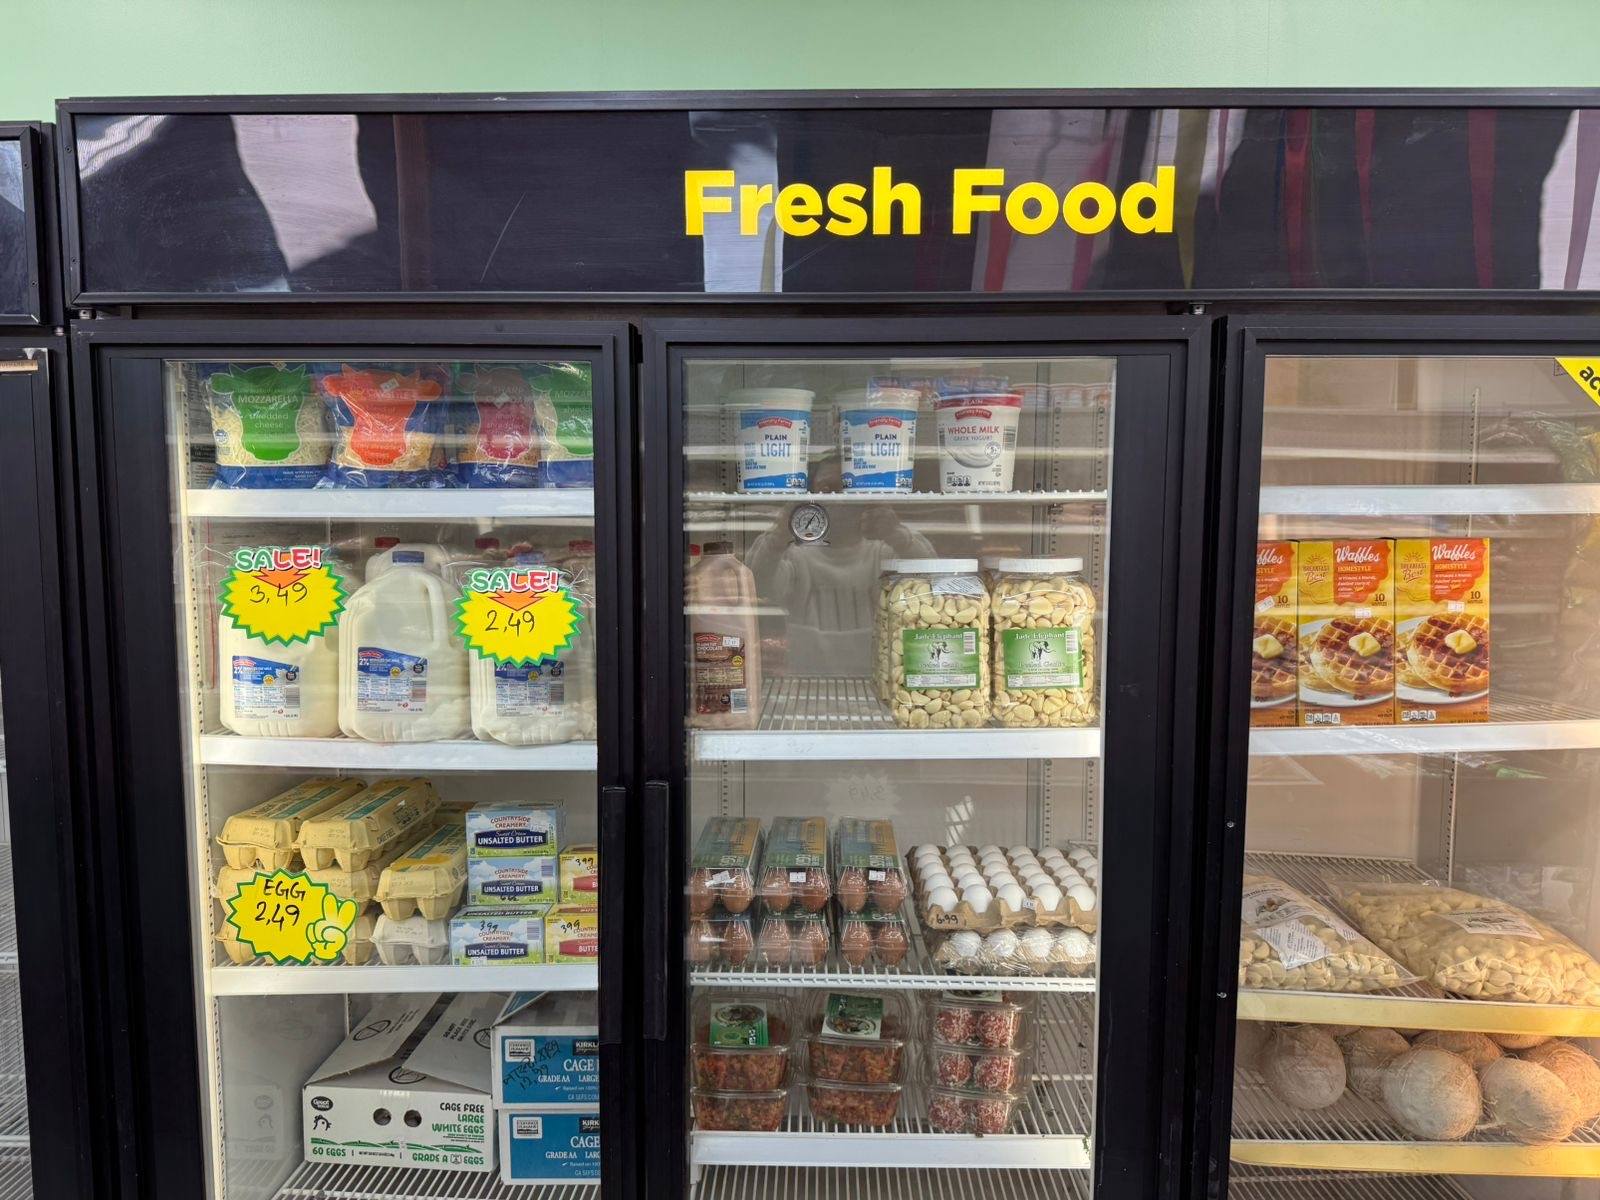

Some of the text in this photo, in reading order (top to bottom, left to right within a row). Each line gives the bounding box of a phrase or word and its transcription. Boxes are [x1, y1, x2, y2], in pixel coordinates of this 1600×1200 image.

[684, 165, 1176, 236] Fresh Food
[238, 394, 299, 403] MOZZARELLA
[947, 425, 1000, 434] WHOLE MILK
[760, 443, 792, 457] LIGHT
[870, 443, 901, 457] LIGHT
[1335, 545, 1380, 563] Waffles
[1431, 543, 1476, 560] Waffles
[235, 546, 322, 572] SALE!
[470, 569, 560, 593] SALE!
[249, 582, 308, 607] 3,49
[1277, 595, 1289, 604] 10
[1375, 593, 1385, 602] 10
[1470, 590, 1481, 599] 10
[485, 609, 535, 637] 2,49
[490, 815, 531, 824] COUNTRYSIDE
[477, 835, 543, 845] UNSALTED BUTTER
[494, 867, 529, 875] COUNTRYSIDE
[263, 879, 306, 901] EGG
[254, 901, 300, 932] 2,49
[467, 948, 499, 956] UNSALTED
[563, 1058, 595, 1072] CAGE
[538, 1074, 561, 1083] GRADE
[561, 1074, 570, 1083] AA
[440, 1102, 485, 1113] CAGE FREE
[457, 1114, 485, 1124] LARGE
[432, 1123, 485, 1134] WHITE EGGS
[570, 1135, 600, 1148] CAGE
[312, 1146, 346, 1157] 60 EGGS
[545, 1151, 568, 1159] GRADE
[567, 1151, 577, 1159] AA
[412, 1152, 484, 1165] GRADE A EGGS
